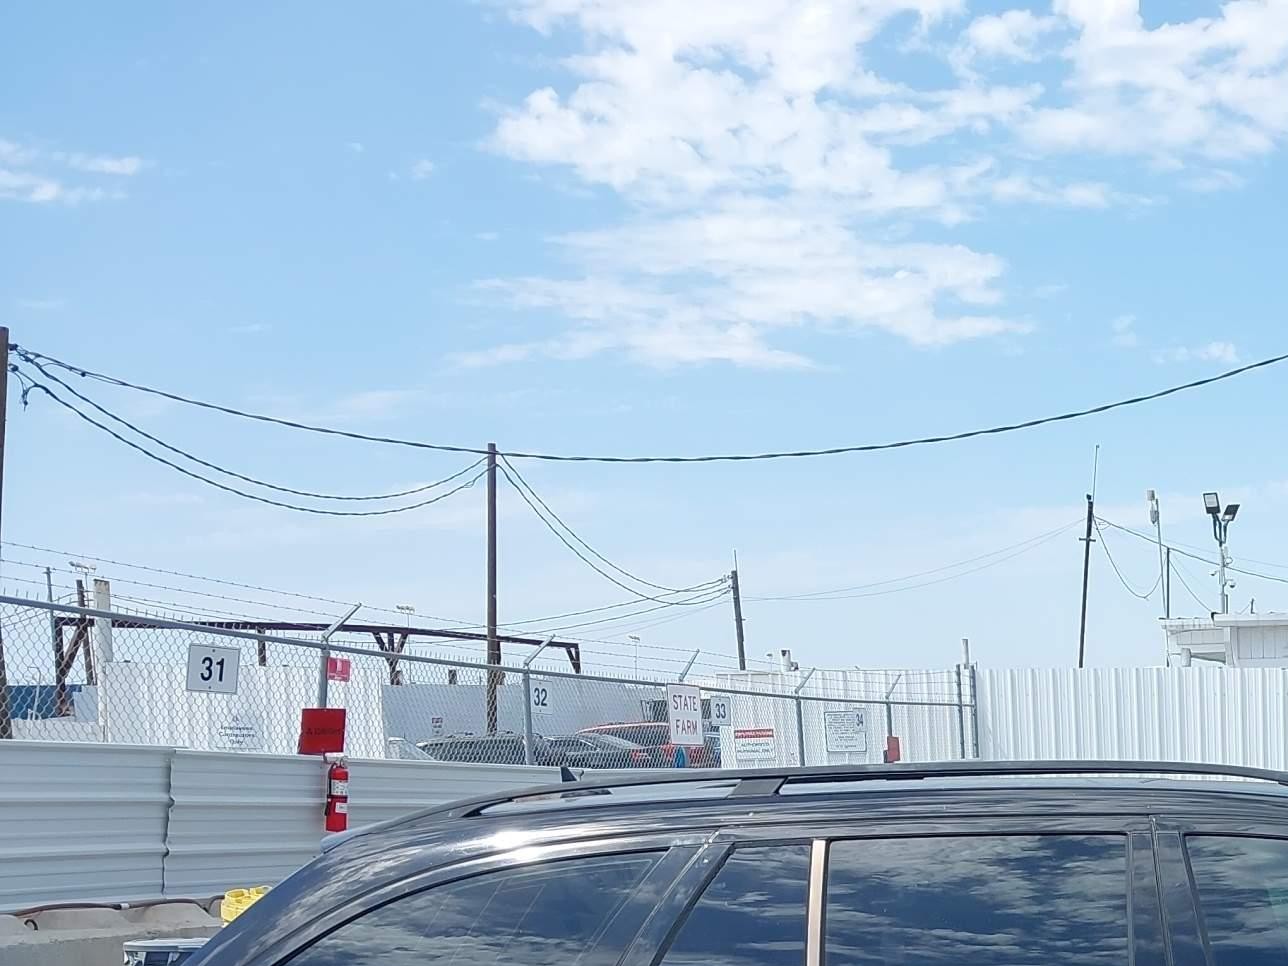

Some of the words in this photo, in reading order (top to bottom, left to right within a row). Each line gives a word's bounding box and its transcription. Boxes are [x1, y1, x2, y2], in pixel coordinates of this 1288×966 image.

[200, 656, 225, 682] 31
[533, 687, 548, 707] 32
[672, 694, 698, 712] STATE
[715, 703, 727, 719] 33
[675, 719, 698, 735] FARM
[855, 713, 864, 727] 34
